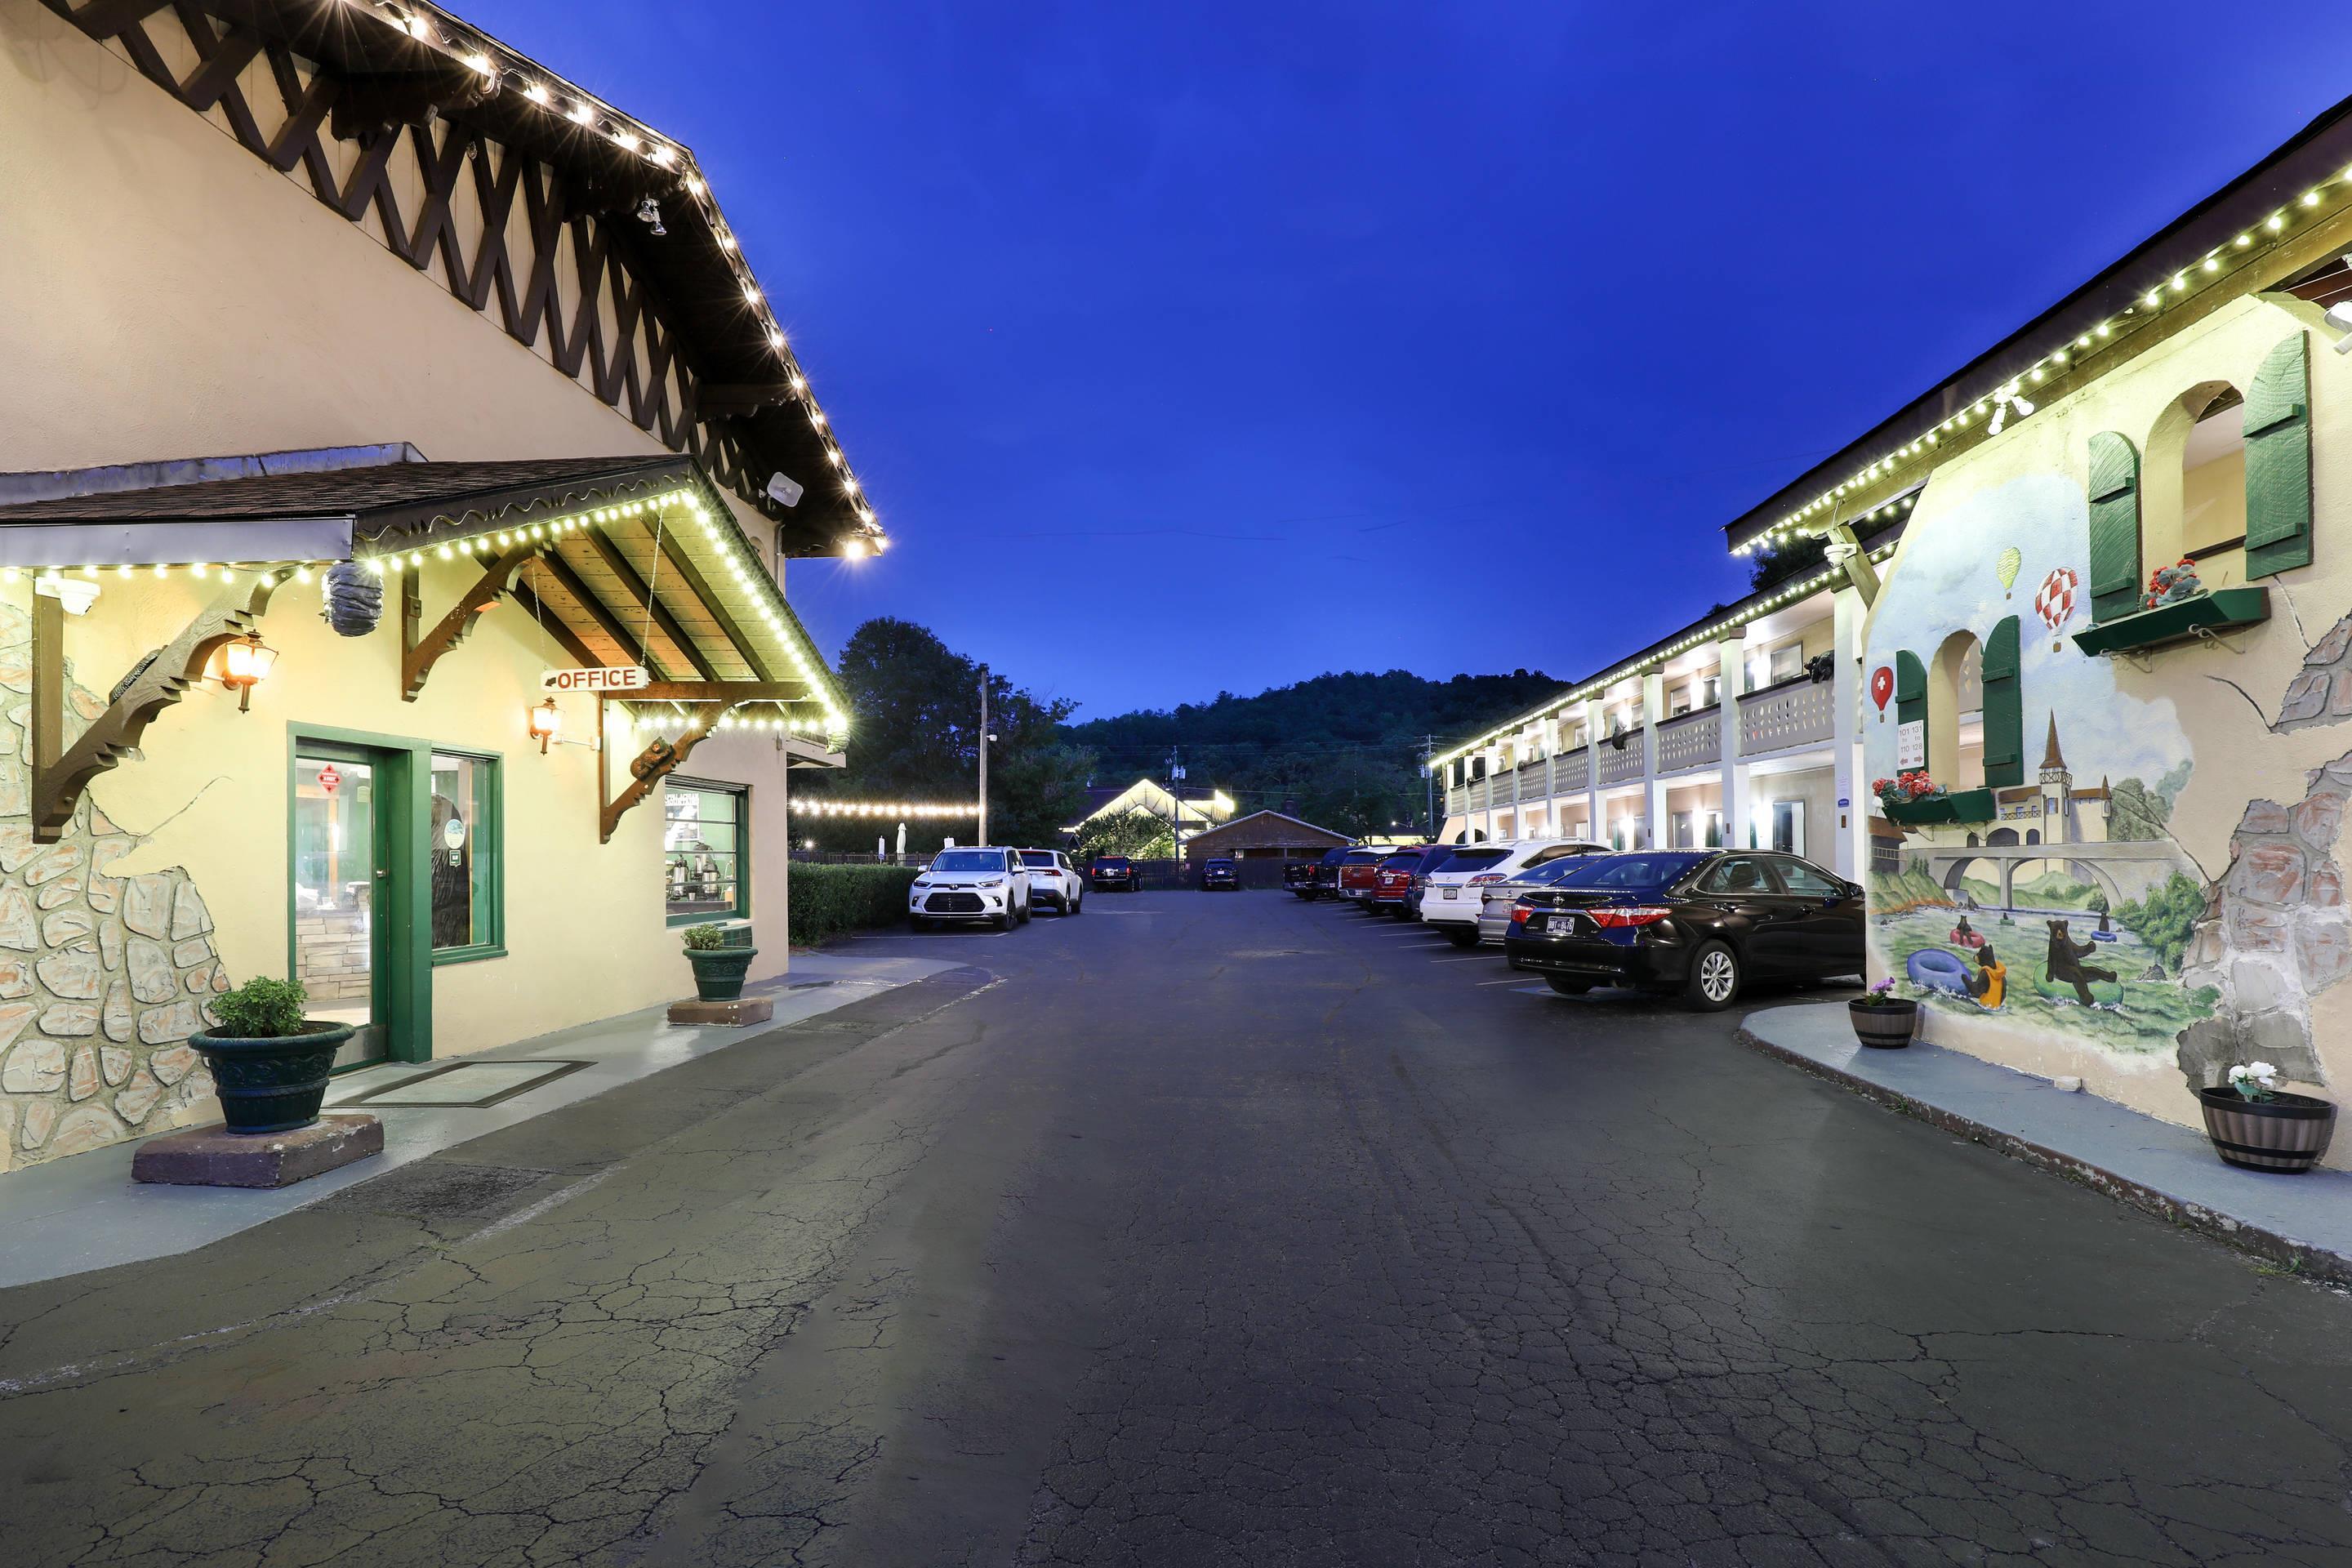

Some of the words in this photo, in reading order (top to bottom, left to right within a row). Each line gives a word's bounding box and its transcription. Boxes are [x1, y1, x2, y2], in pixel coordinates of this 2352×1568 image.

[557, 669, 636, 688] OFFICE
[1900, 728, 1909, 737] 101
[1912, 725, 1922, 733] 131
